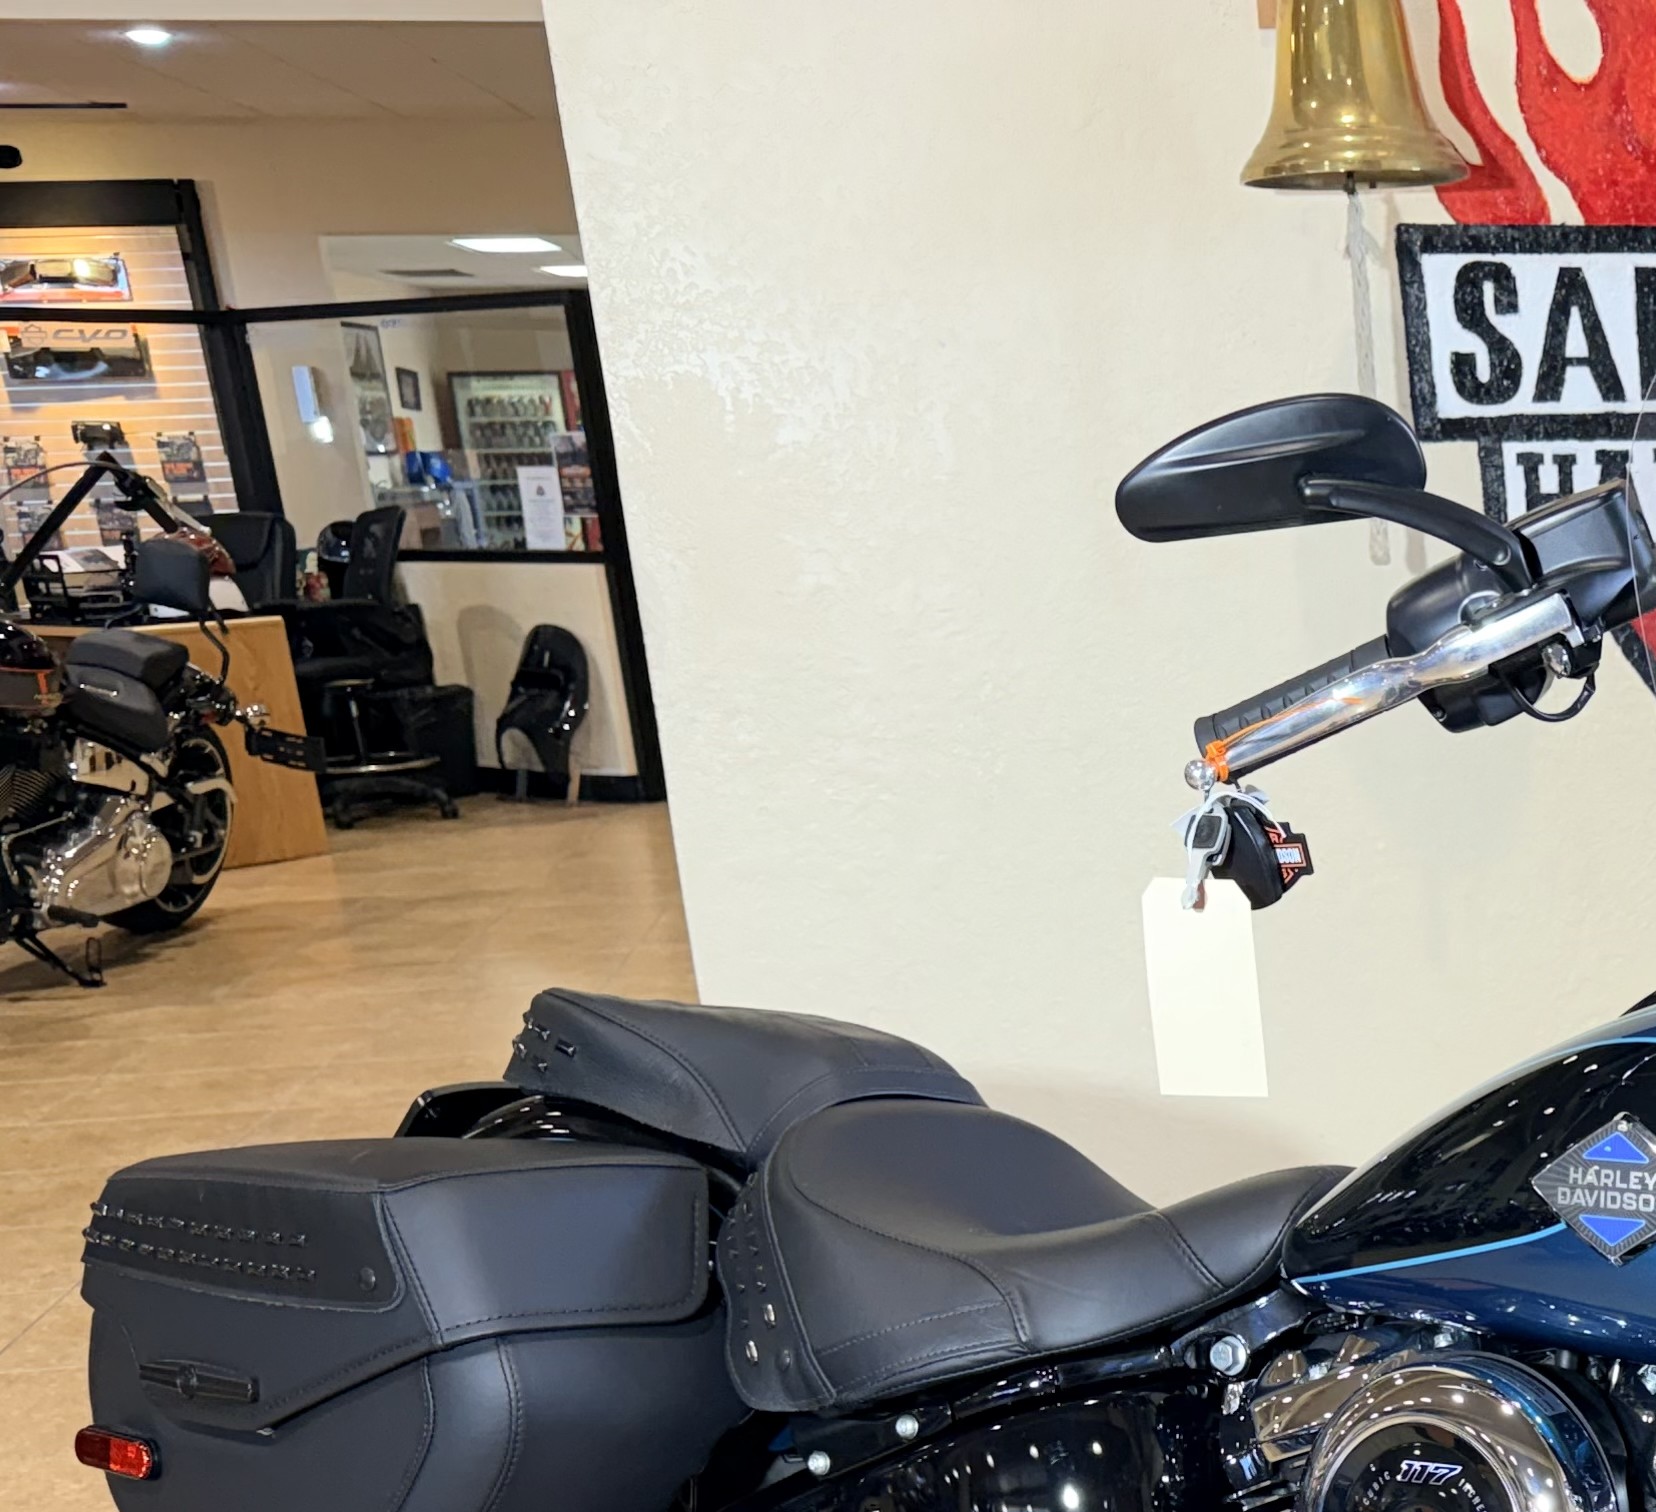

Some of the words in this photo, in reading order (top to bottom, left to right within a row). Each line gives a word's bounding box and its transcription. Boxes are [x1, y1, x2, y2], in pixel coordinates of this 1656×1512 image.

[52, 328, 128, 343] CVO
[1362, 1470, 1391, 1506] CUBIC
[1396, 1459, 1463, 1486] 117
